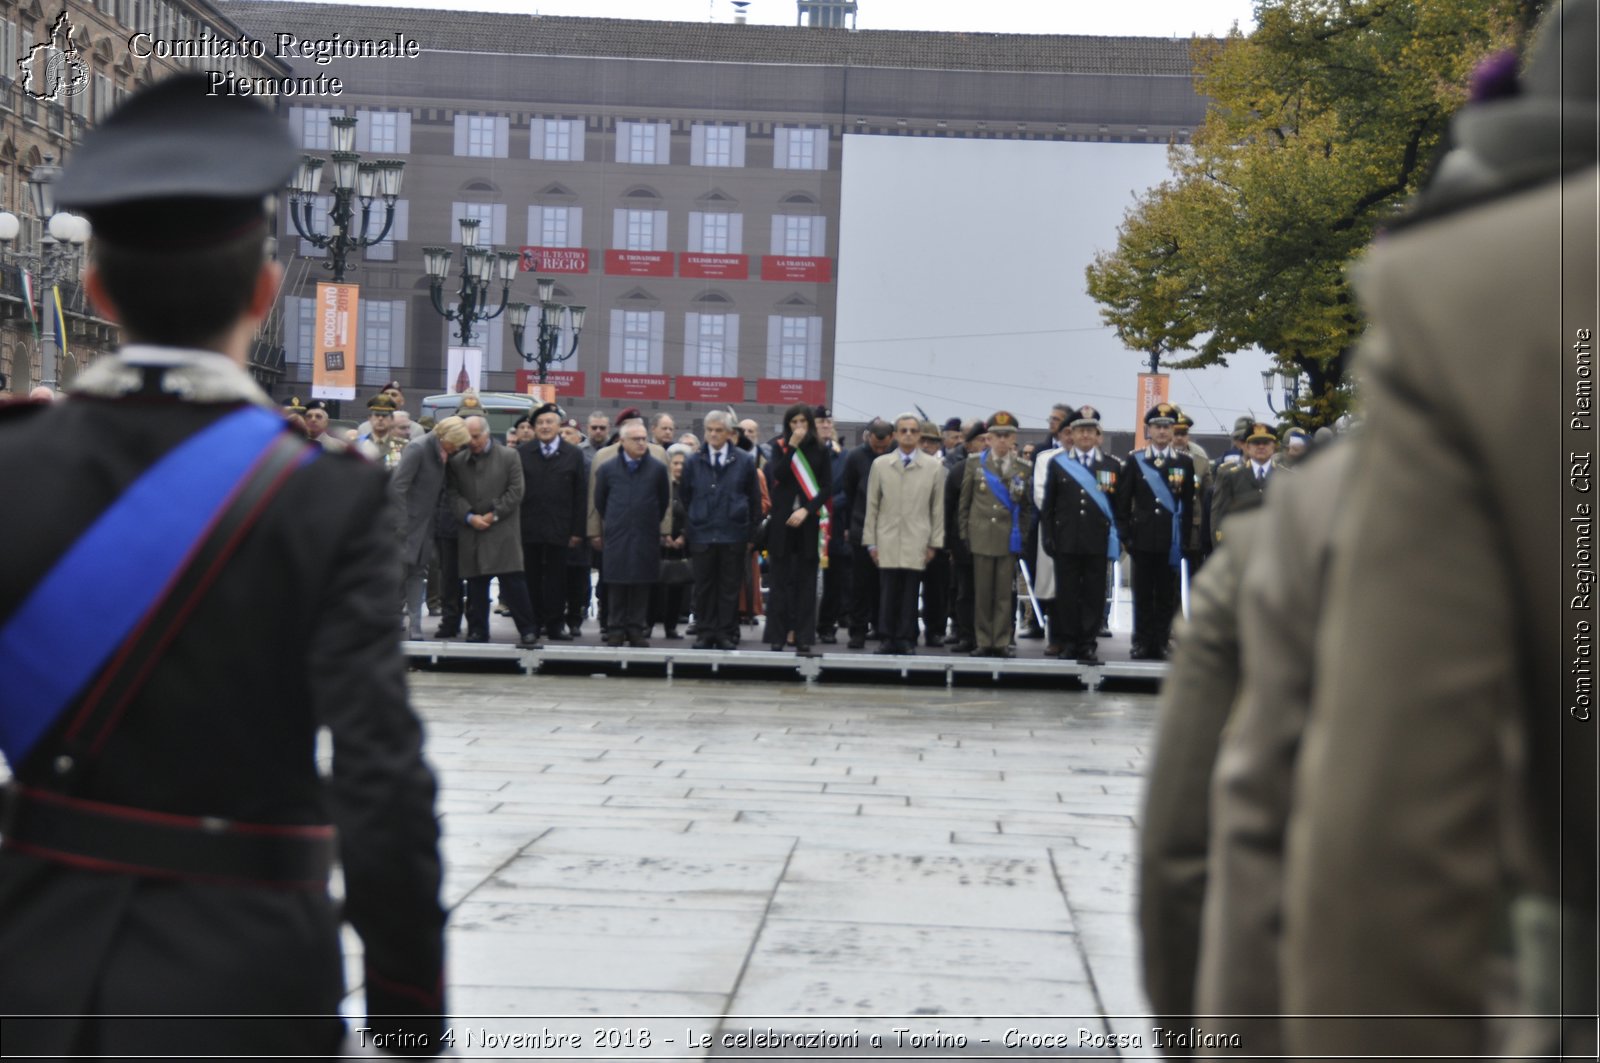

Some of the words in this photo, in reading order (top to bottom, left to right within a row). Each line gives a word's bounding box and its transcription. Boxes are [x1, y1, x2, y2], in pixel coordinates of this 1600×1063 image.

[554, 251, 585, 259] TEATRO
[543, 258, 585, 270] REGIO
[337, 287, 349, 311] 2018
